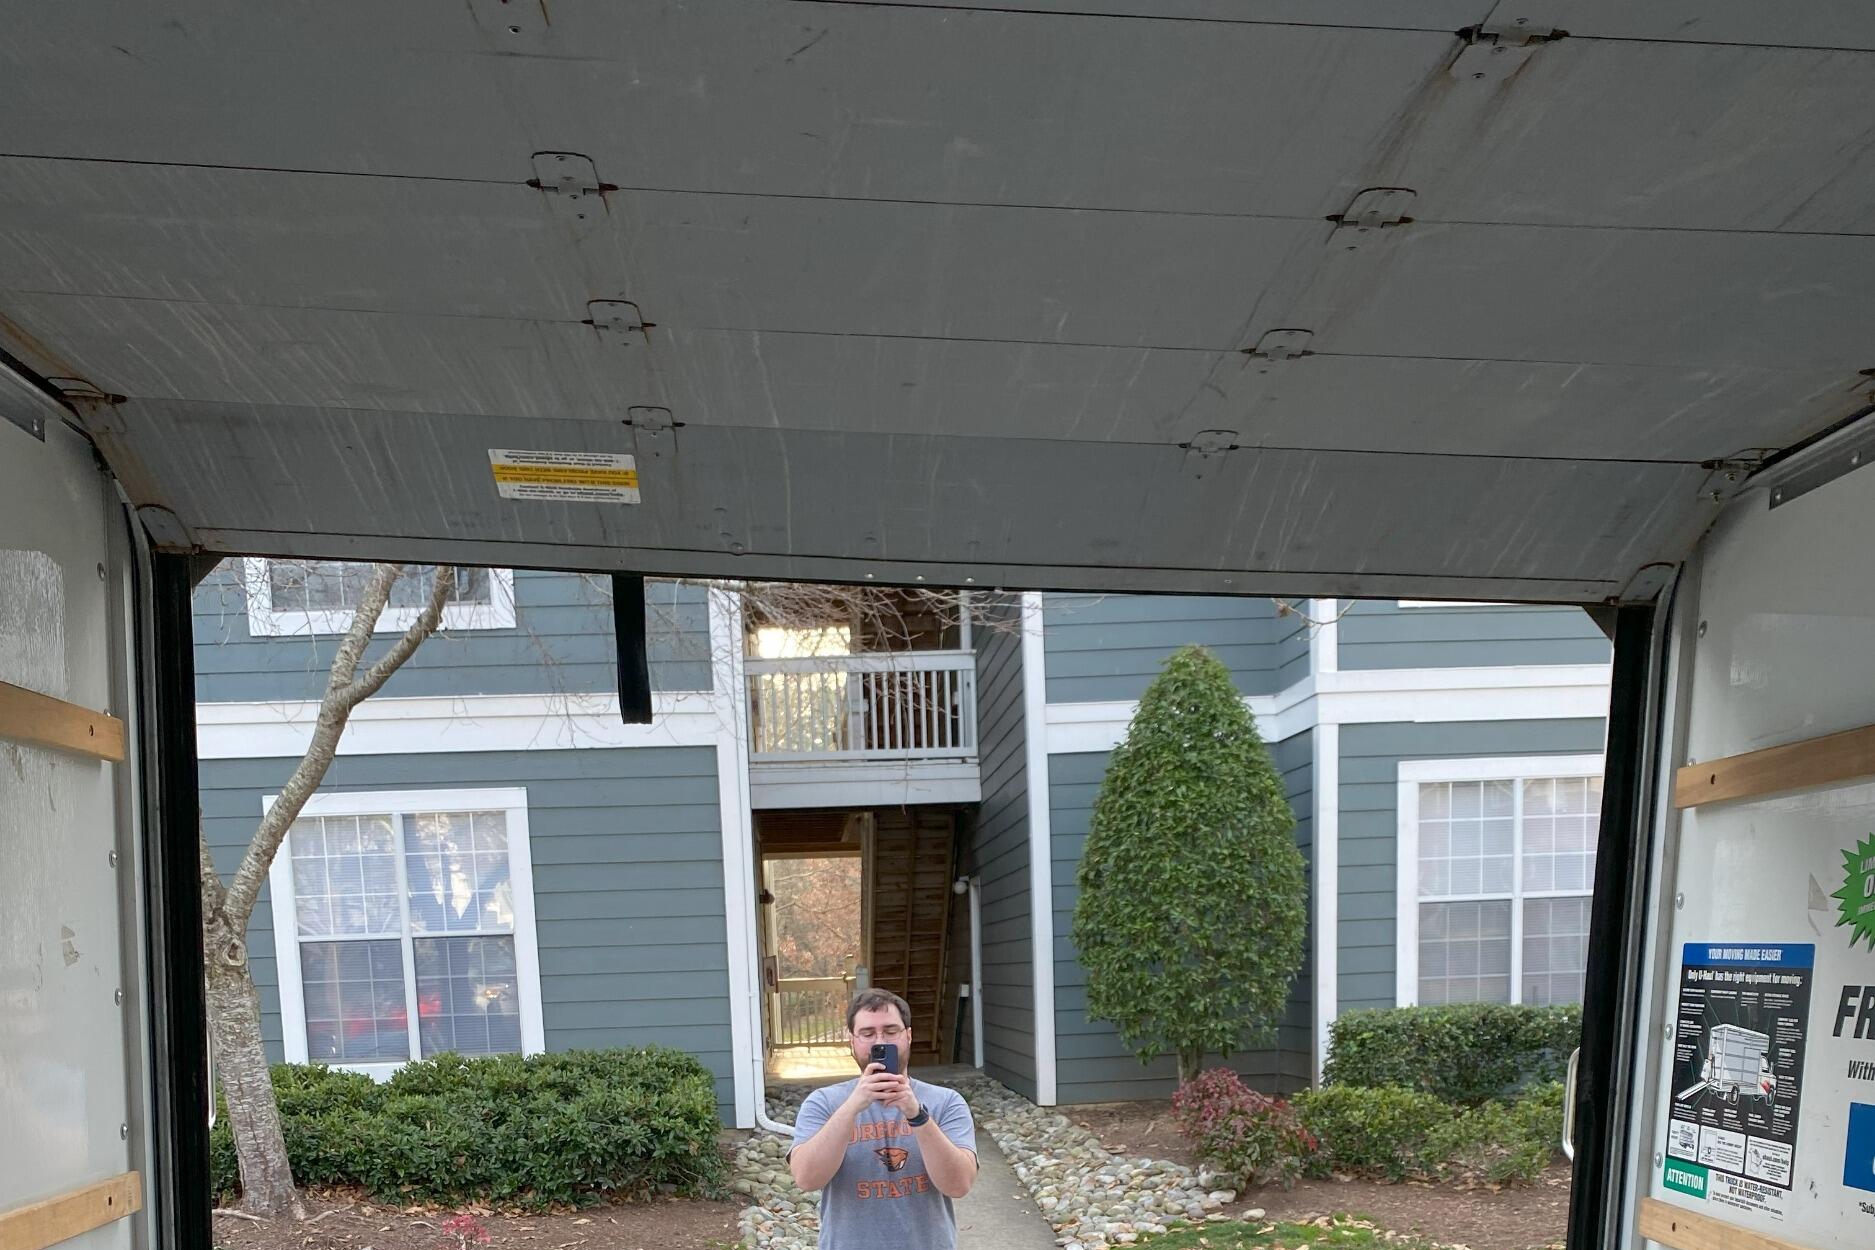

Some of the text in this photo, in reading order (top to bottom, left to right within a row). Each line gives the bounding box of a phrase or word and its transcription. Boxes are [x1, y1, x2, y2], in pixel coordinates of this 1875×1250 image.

[1708, 948, 1782, 961] YOUR MOVING MADE EASIER
[848, 1120, 913, 1146] OREGO
[856, 1173, 929, 1200] STATE
[1666, 1168, 1704, 1190] ATTENTION
